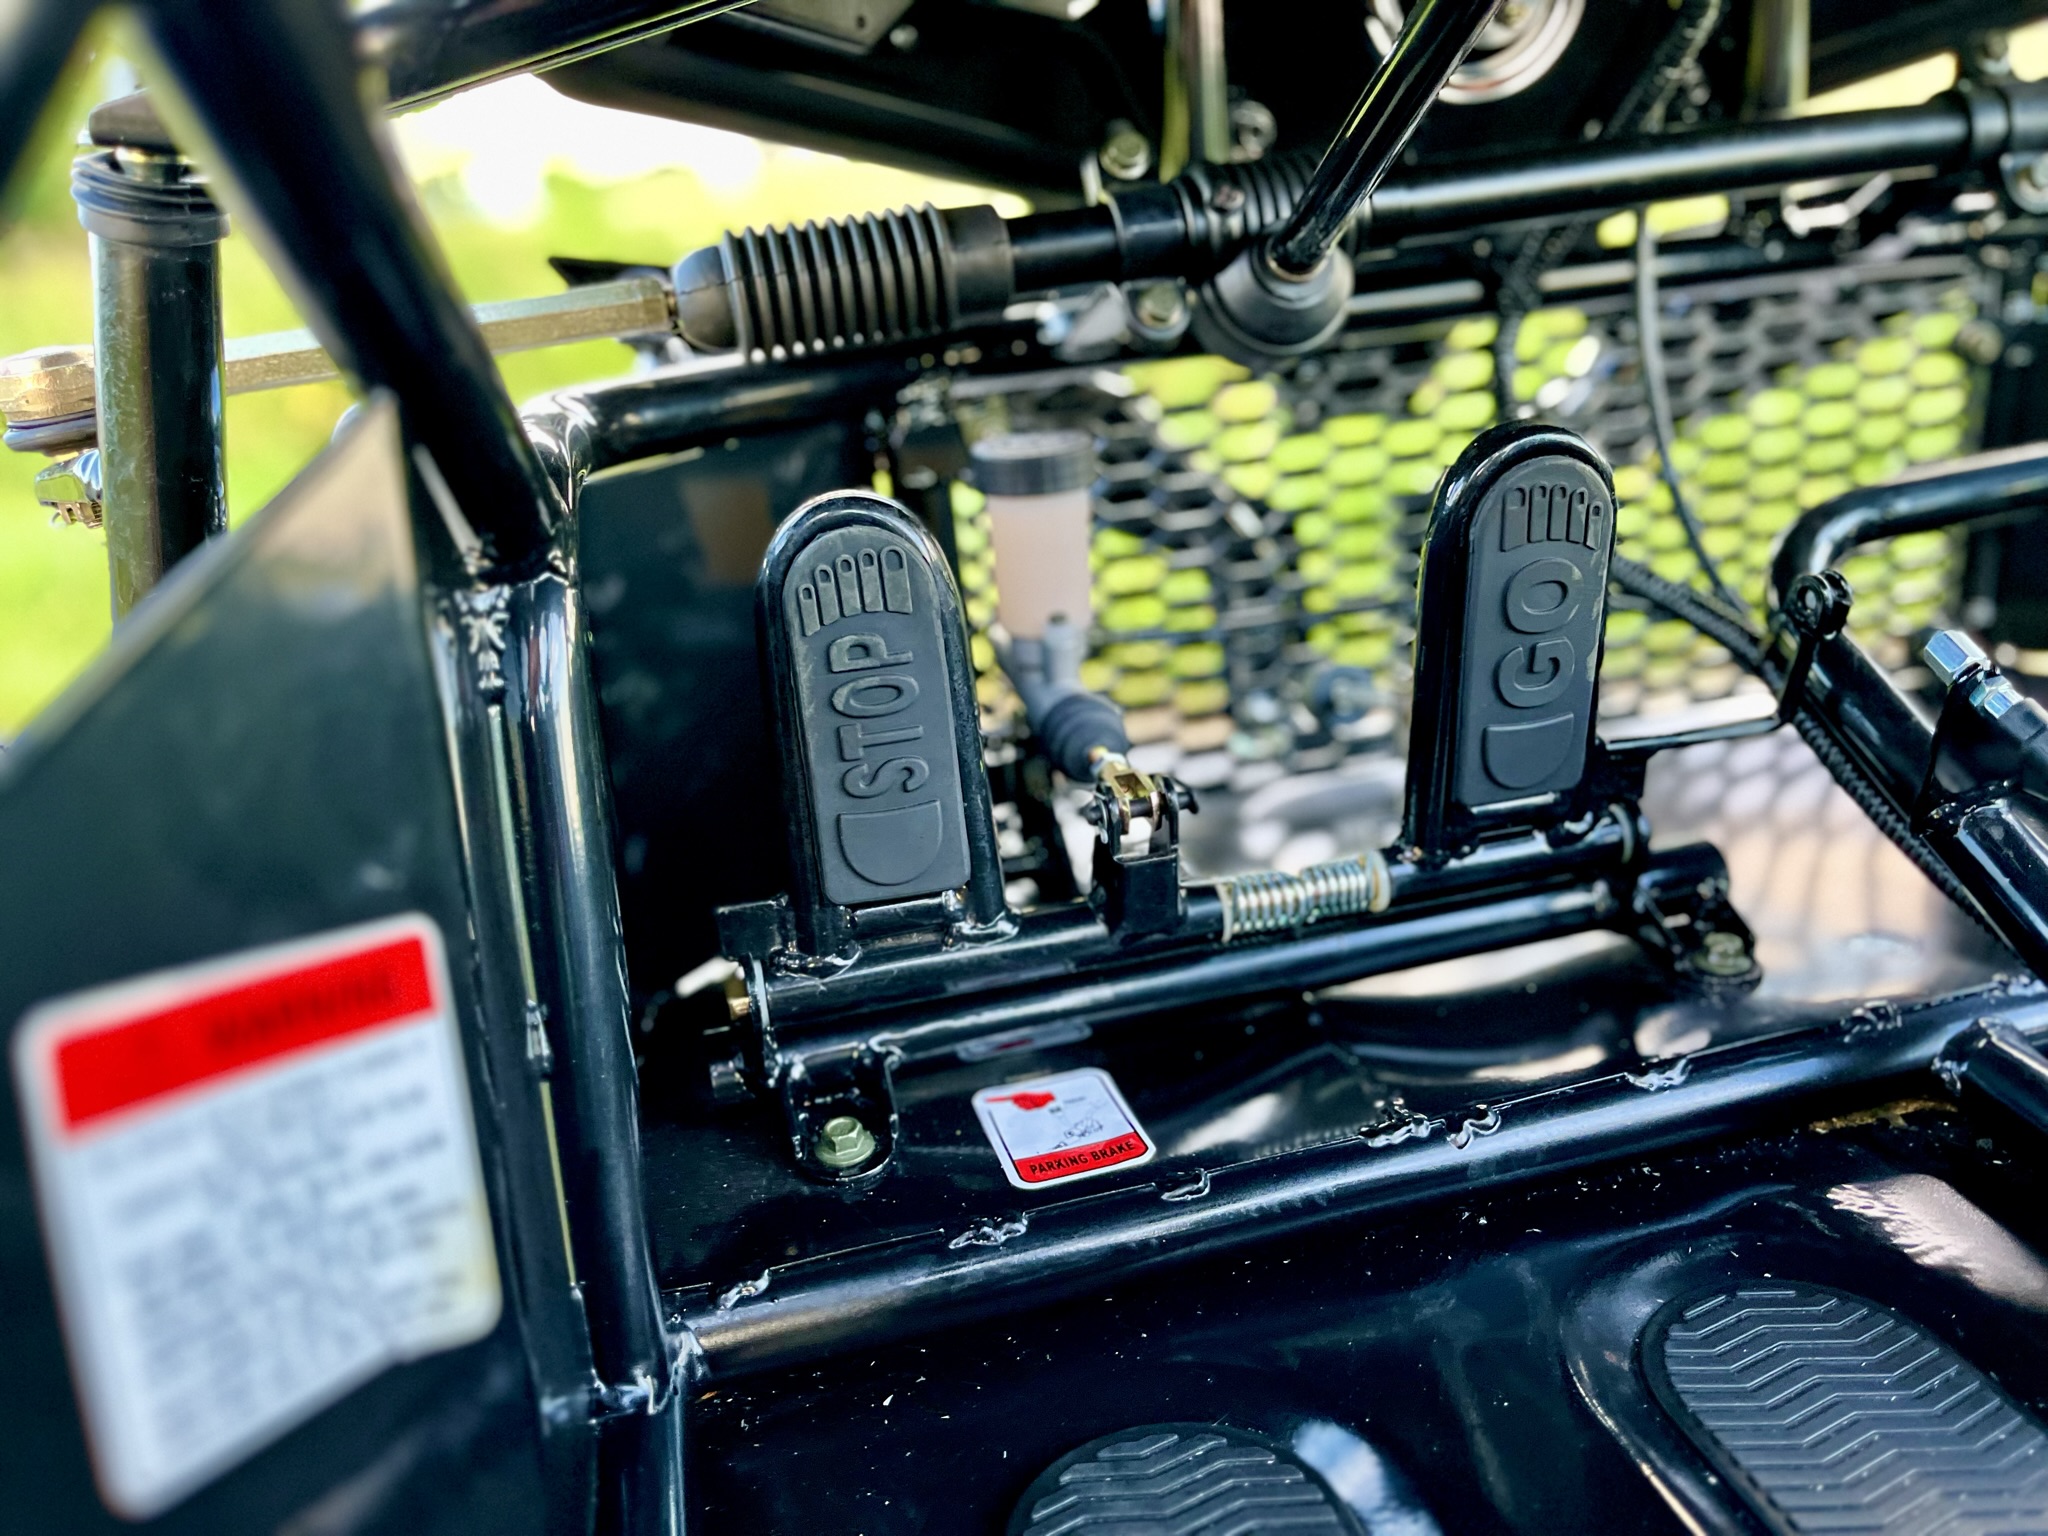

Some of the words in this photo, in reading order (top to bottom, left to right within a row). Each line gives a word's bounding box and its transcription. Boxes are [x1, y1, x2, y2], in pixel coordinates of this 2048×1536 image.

[1497, 557, 1584, 708] GO
[828, 633, 930, 798] STOP
[1029, 1154, 1088, 1175] PARKING
[1092, 1140, 1135, 1161] BRAKE
